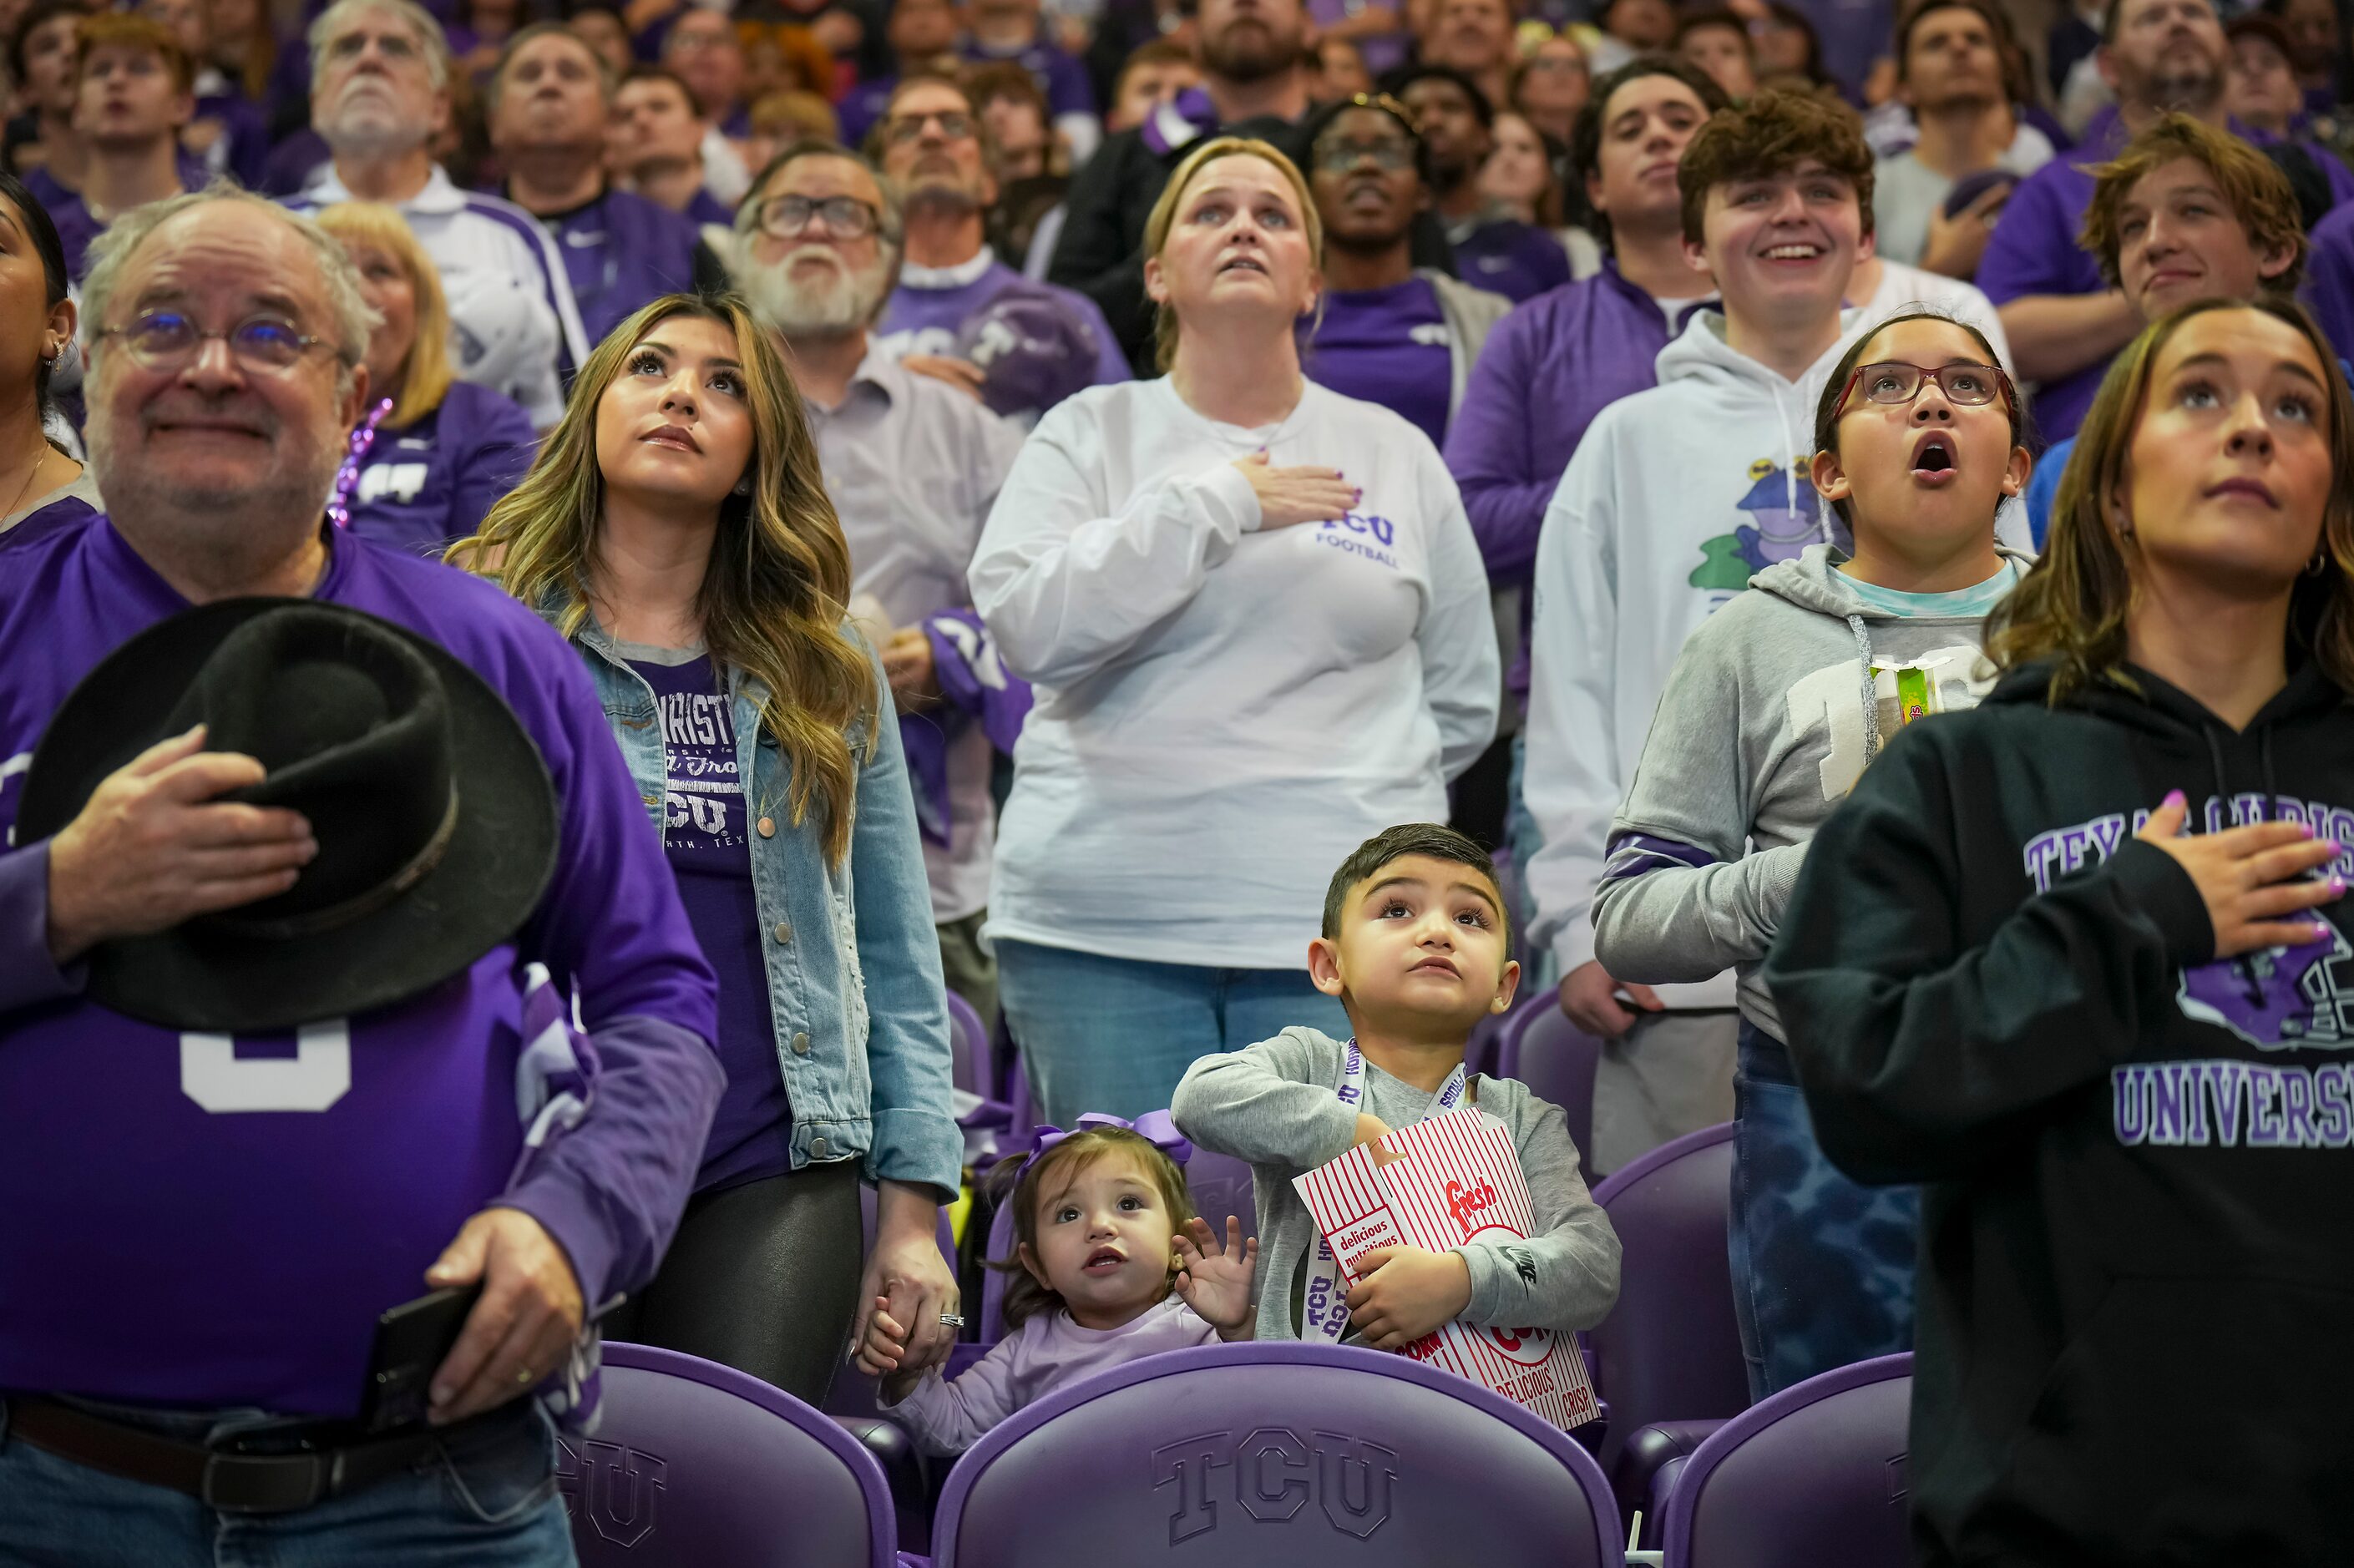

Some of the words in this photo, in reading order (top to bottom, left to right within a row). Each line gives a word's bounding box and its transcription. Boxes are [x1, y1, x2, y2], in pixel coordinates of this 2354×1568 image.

[1316, 533, 1400, 569] FOOTBALL
[2111, 1057, 2354, 1148] UNIVERS
[1445, 1176, 1497, 1233] fresh
[1340, 1221, 1388, 1251] delicious
[1307, 1276, 1333, 1326] TCU
[1562, 1386, 1589, 1419] CRISP
[1151, 1426, 1400, 1546] TCU
